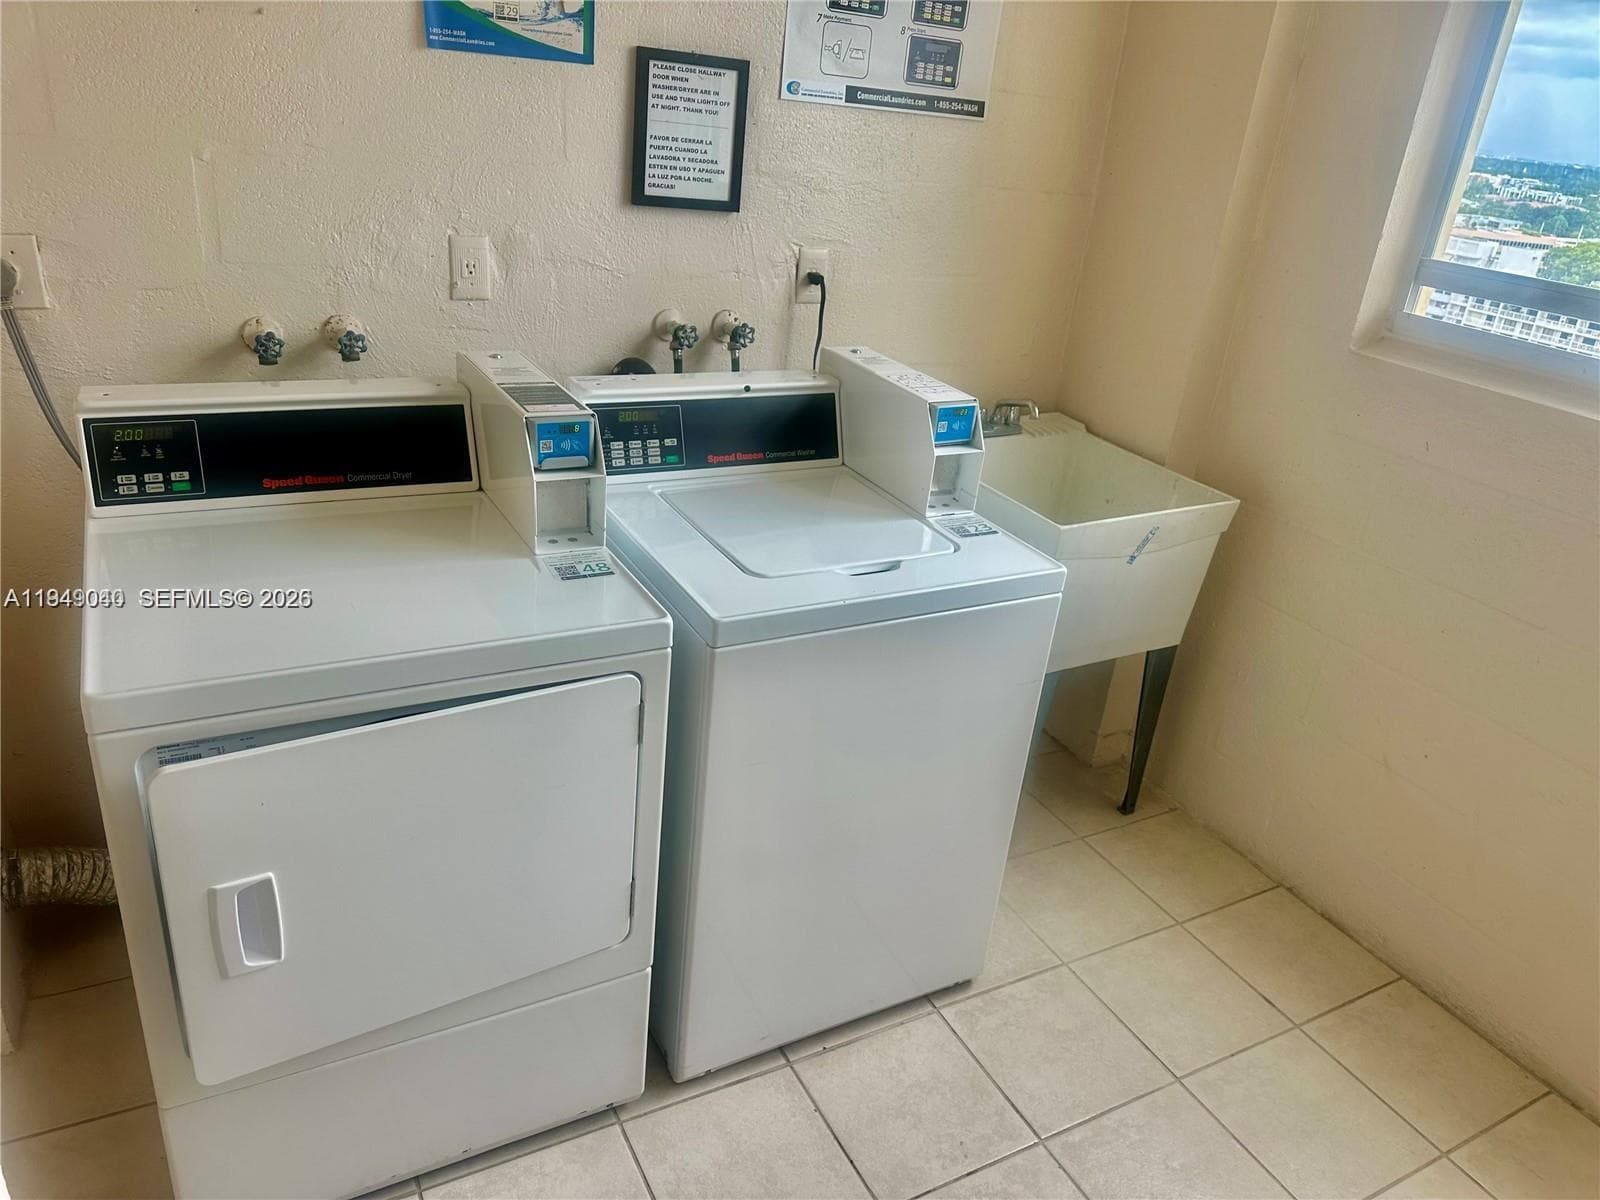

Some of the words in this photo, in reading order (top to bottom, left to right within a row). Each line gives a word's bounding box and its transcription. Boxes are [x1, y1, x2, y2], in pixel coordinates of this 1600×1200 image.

[506, 7, 518, 16] 29
[816, 13, 822, 22] 7
[901, 26, 905, 35] 8
[678, 66, 696, 74] CLOSE
[698, 69, 727, 78] HALLWAY
[653, 73, 670, 82] DOOR
[857, 91, 927, 106] CommercialLaundries.com
[934, 101, 978, 113] 1-855-254-WASH
[649, 144, 673, 152] PUERTA
[649, 154, 680, 162] LAVADORA
[707, 454, 736, 464] Speed
[737, 452, 764, 461] Queen
[765, 450, 796, 458] Commercial
[263, 477, 303, 489] Speed
[305, 475, 344, 485] Queen
[347, 472, 391, 482] Commercial
[393, 471, 413, 481] Dryer
[968, 524, 992, 532] 23
[583, 562, 611, 572] 48
